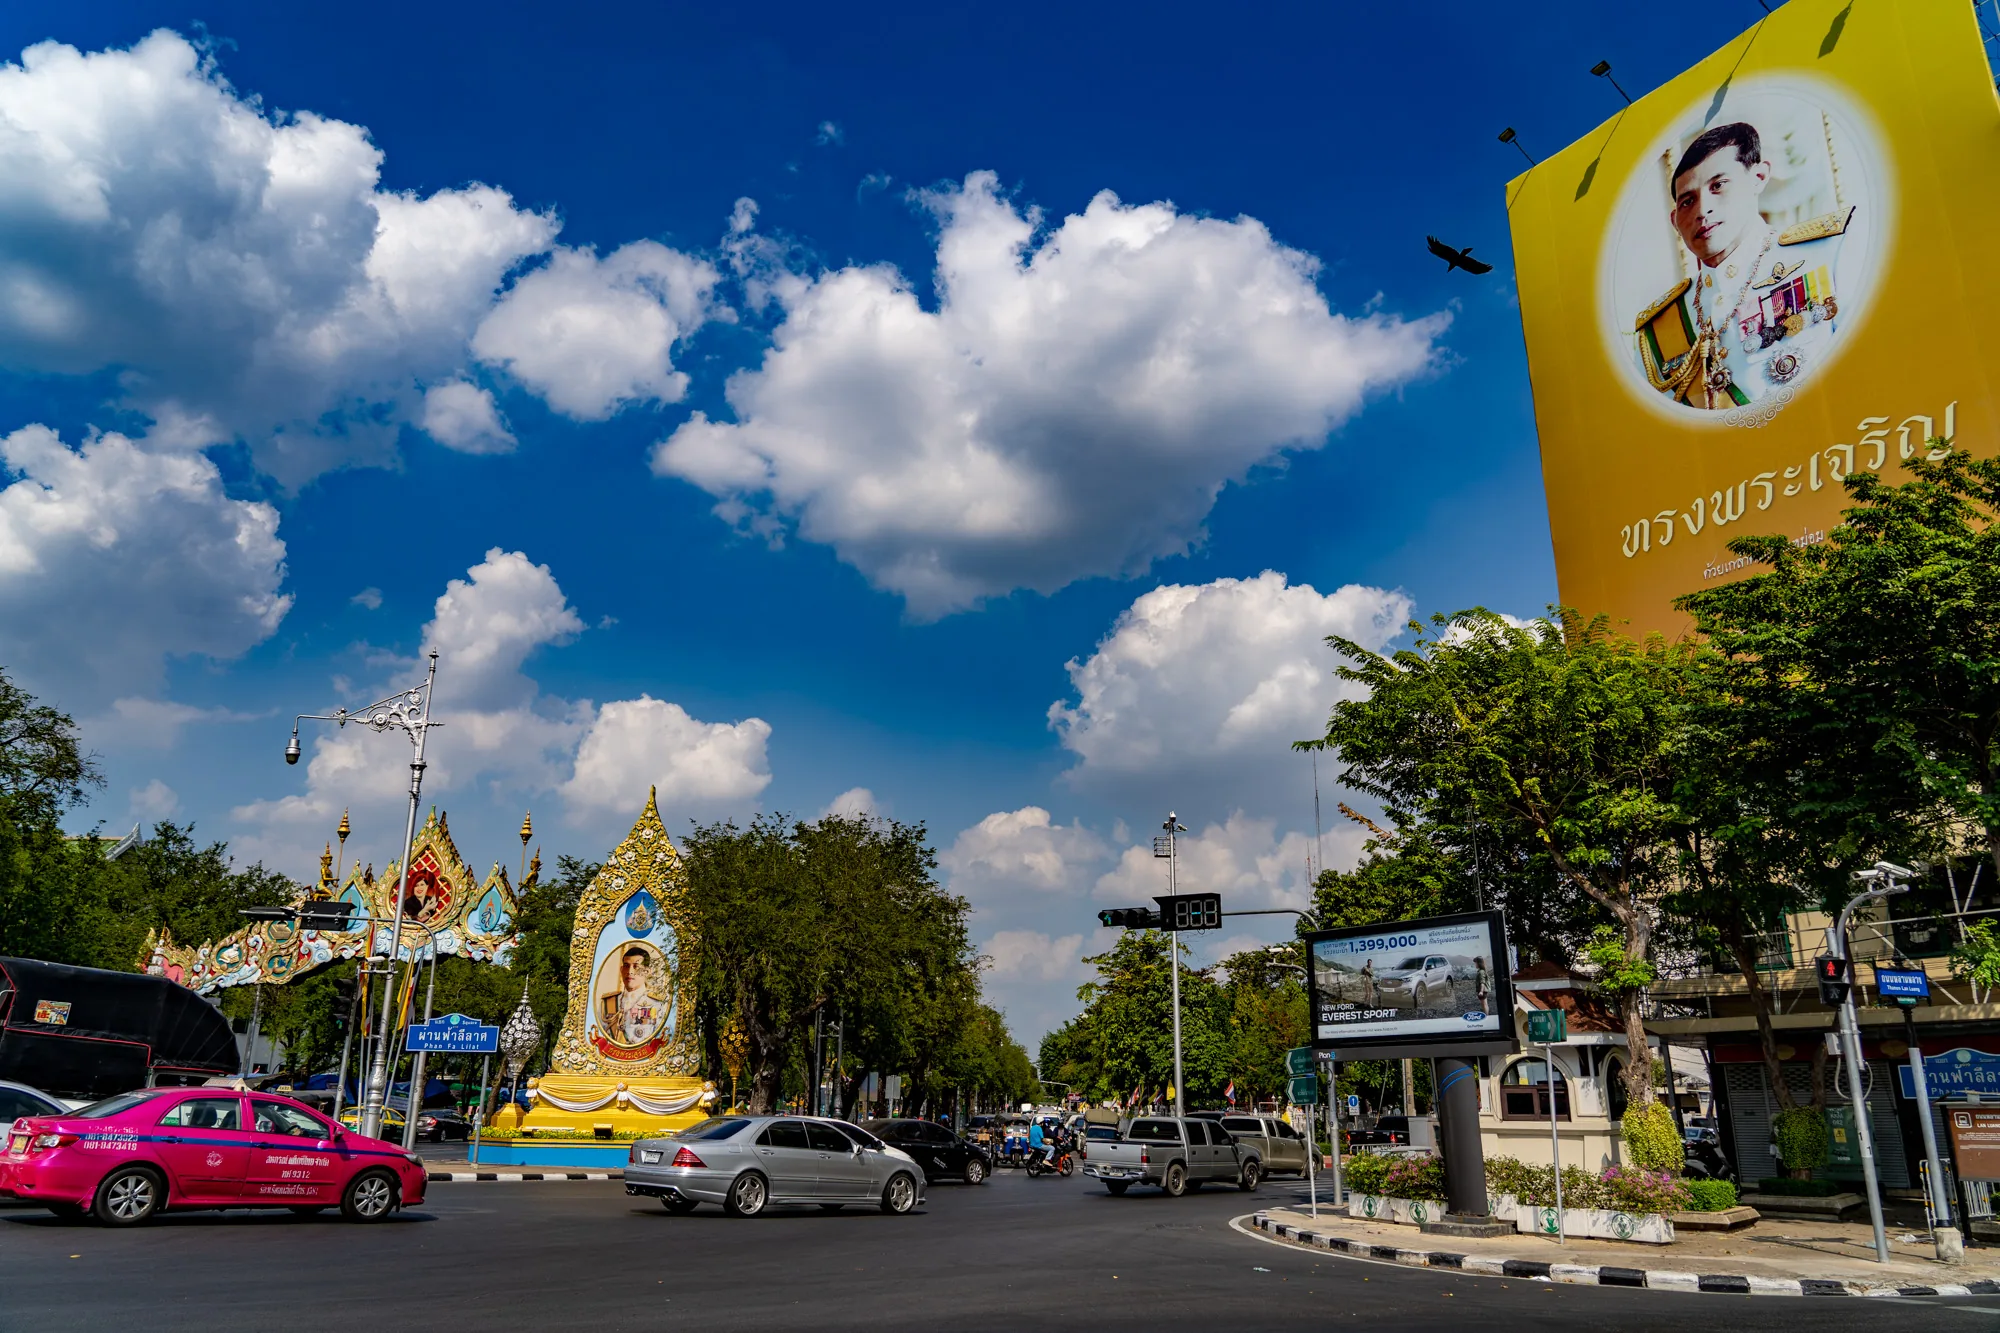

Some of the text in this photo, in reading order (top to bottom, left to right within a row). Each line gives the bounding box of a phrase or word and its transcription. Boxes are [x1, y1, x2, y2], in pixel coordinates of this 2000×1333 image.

[1621, 400, 1958, 558] ทรงพระเจริญ
[1349, 934, 1417, 954] 1,399,000
[1322, 1008, 1396, 1021] EVEREST SPORT
[1466, 1012, 1482, 1021] Ford
[418, 1026, 487, 1042] ผ่านฟ้าลีลาศ
